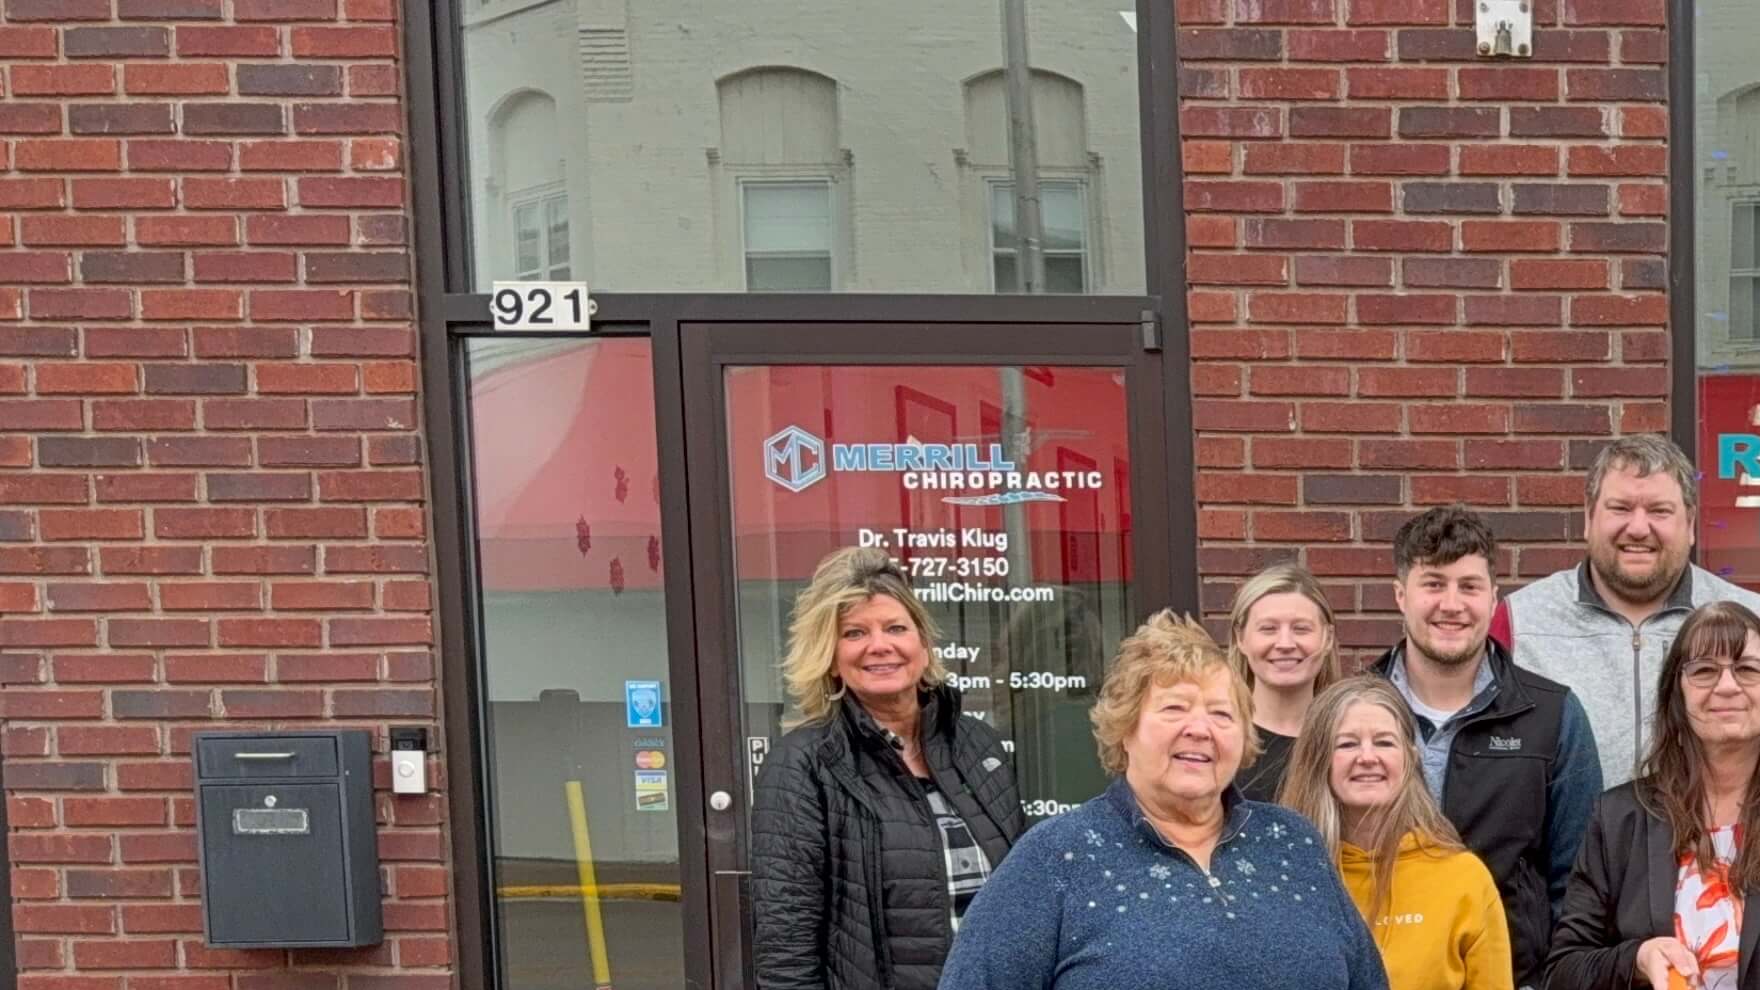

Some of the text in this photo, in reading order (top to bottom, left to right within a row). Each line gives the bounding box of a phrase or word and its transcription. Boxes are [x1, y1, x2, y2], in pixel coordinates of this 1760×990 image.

[495, 288, 581, 325] 921
[833, 443, 1015, 471] MERRILL
[903, 471, 1103, 489] CHIROPRACTIC
[859, 528, 1008, 551] Dr. Travis Klug
[914, 583, 1054, 601] rrillChiro.com
[932, 642, 980, 662] nday
[1010, 671, 1086, 692] 5:30pm
